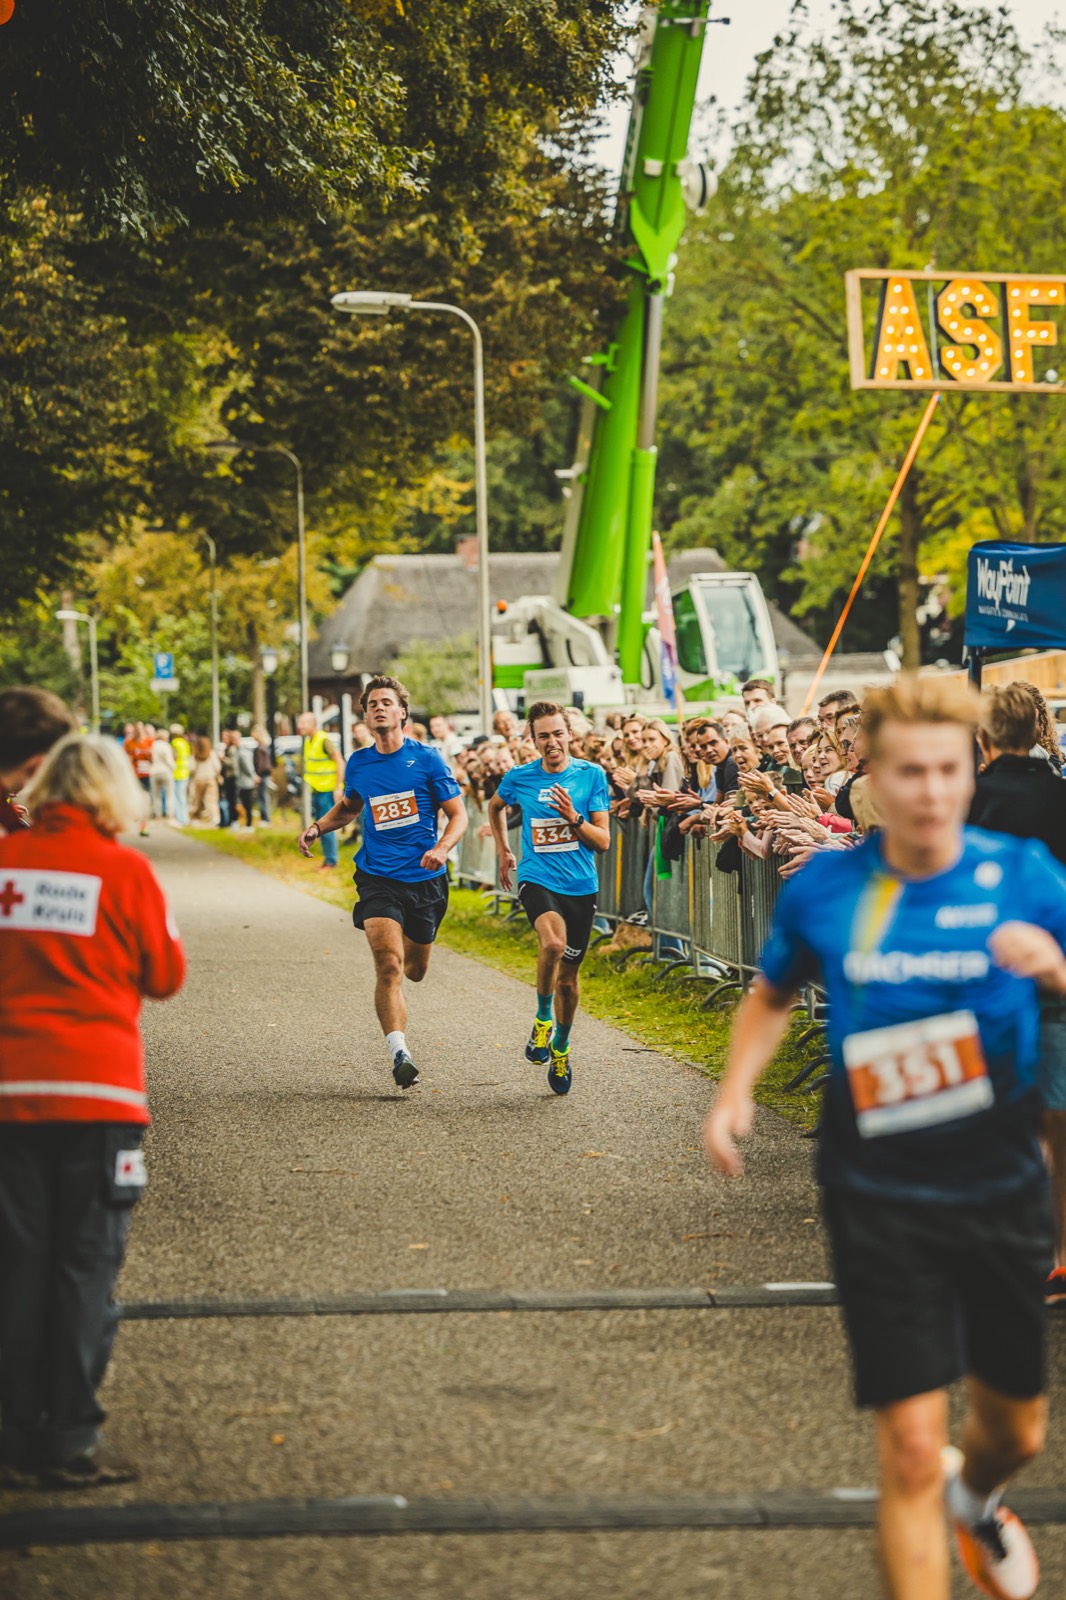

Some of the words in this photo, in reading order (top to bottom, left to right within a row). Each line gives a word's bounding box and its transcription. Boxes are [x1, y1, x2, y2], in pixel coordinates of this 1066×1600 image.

[376, 800, 412, 822] 283
[535, 825, 573, 844] 334
[869, 1042, 964, 1105] 351
